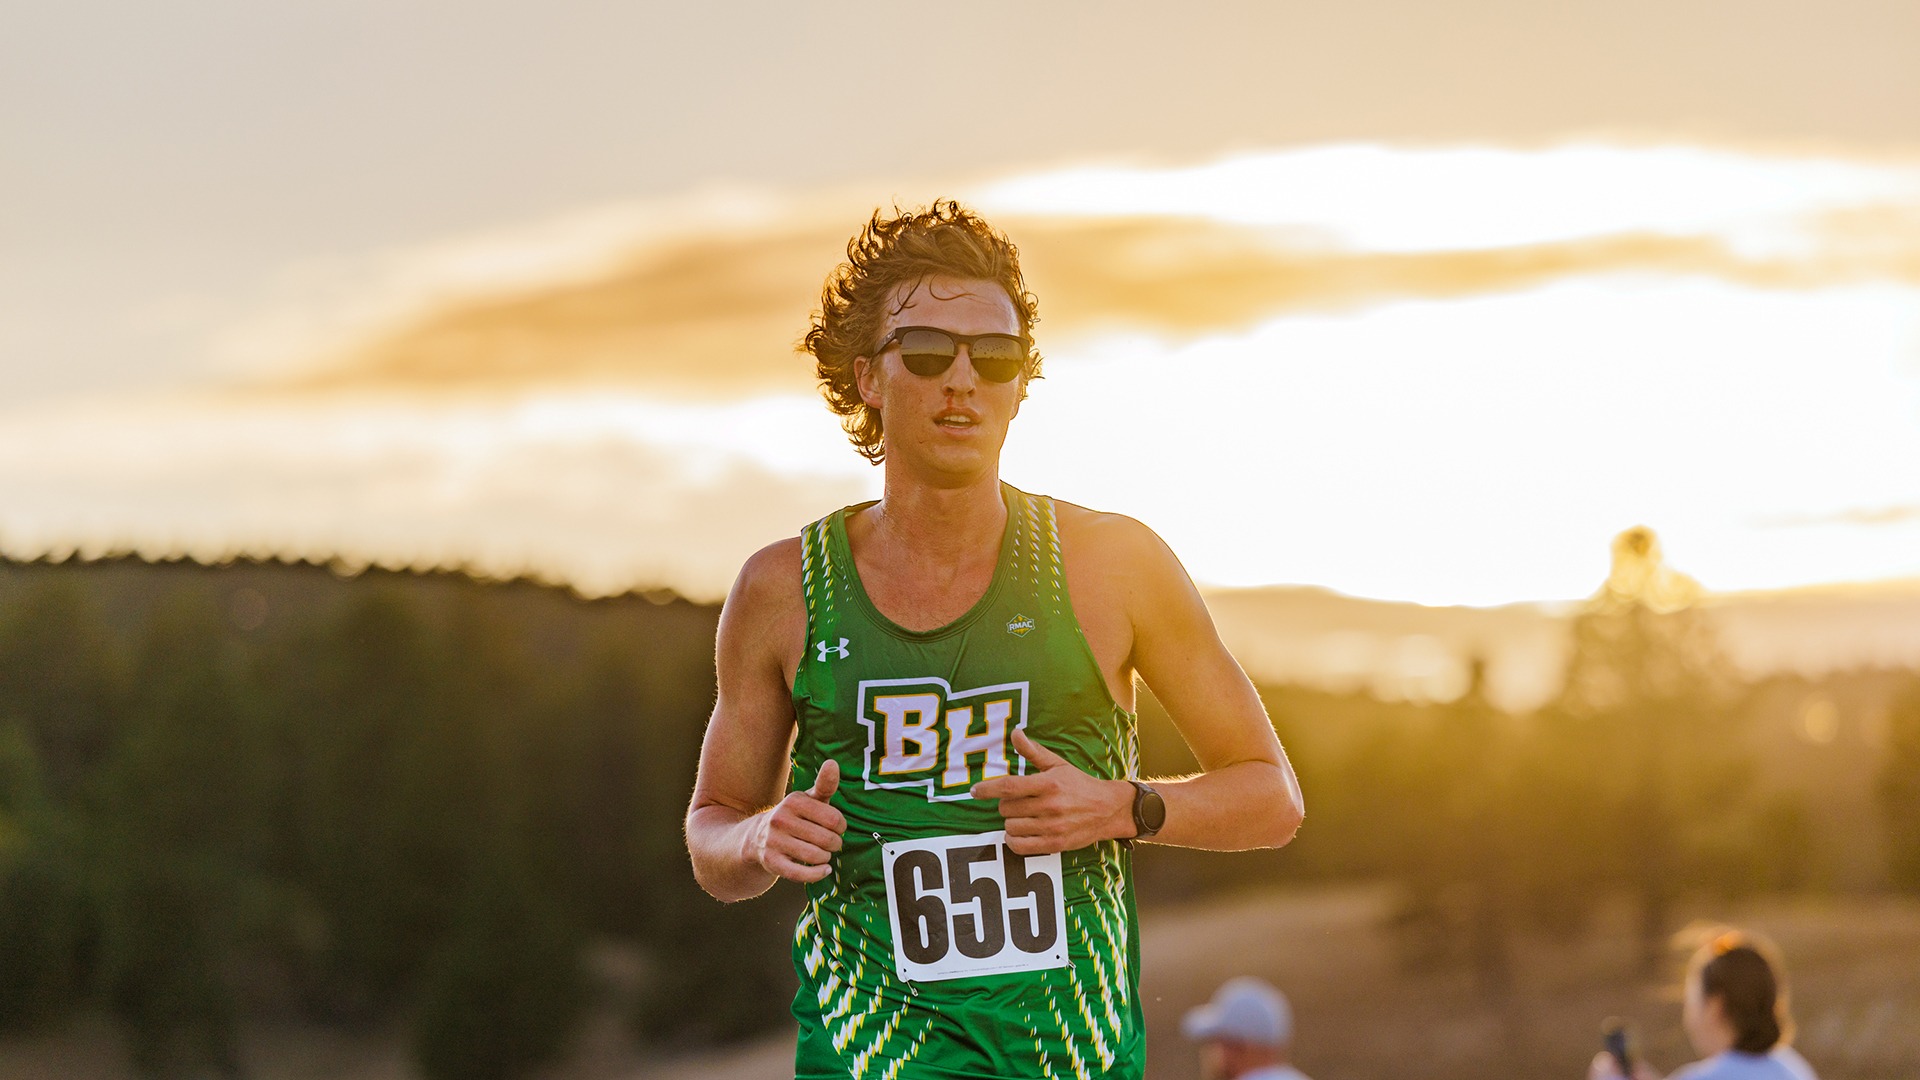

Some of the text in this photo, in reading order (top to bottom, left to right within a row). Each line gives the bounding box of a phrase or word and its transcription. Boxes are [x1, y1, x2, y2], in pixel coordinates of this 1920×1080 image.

[1009, 620, 1033, 631] RMAC
[873, 692, 1012, 788] BH
[893, 843, 1058, 965] 655
